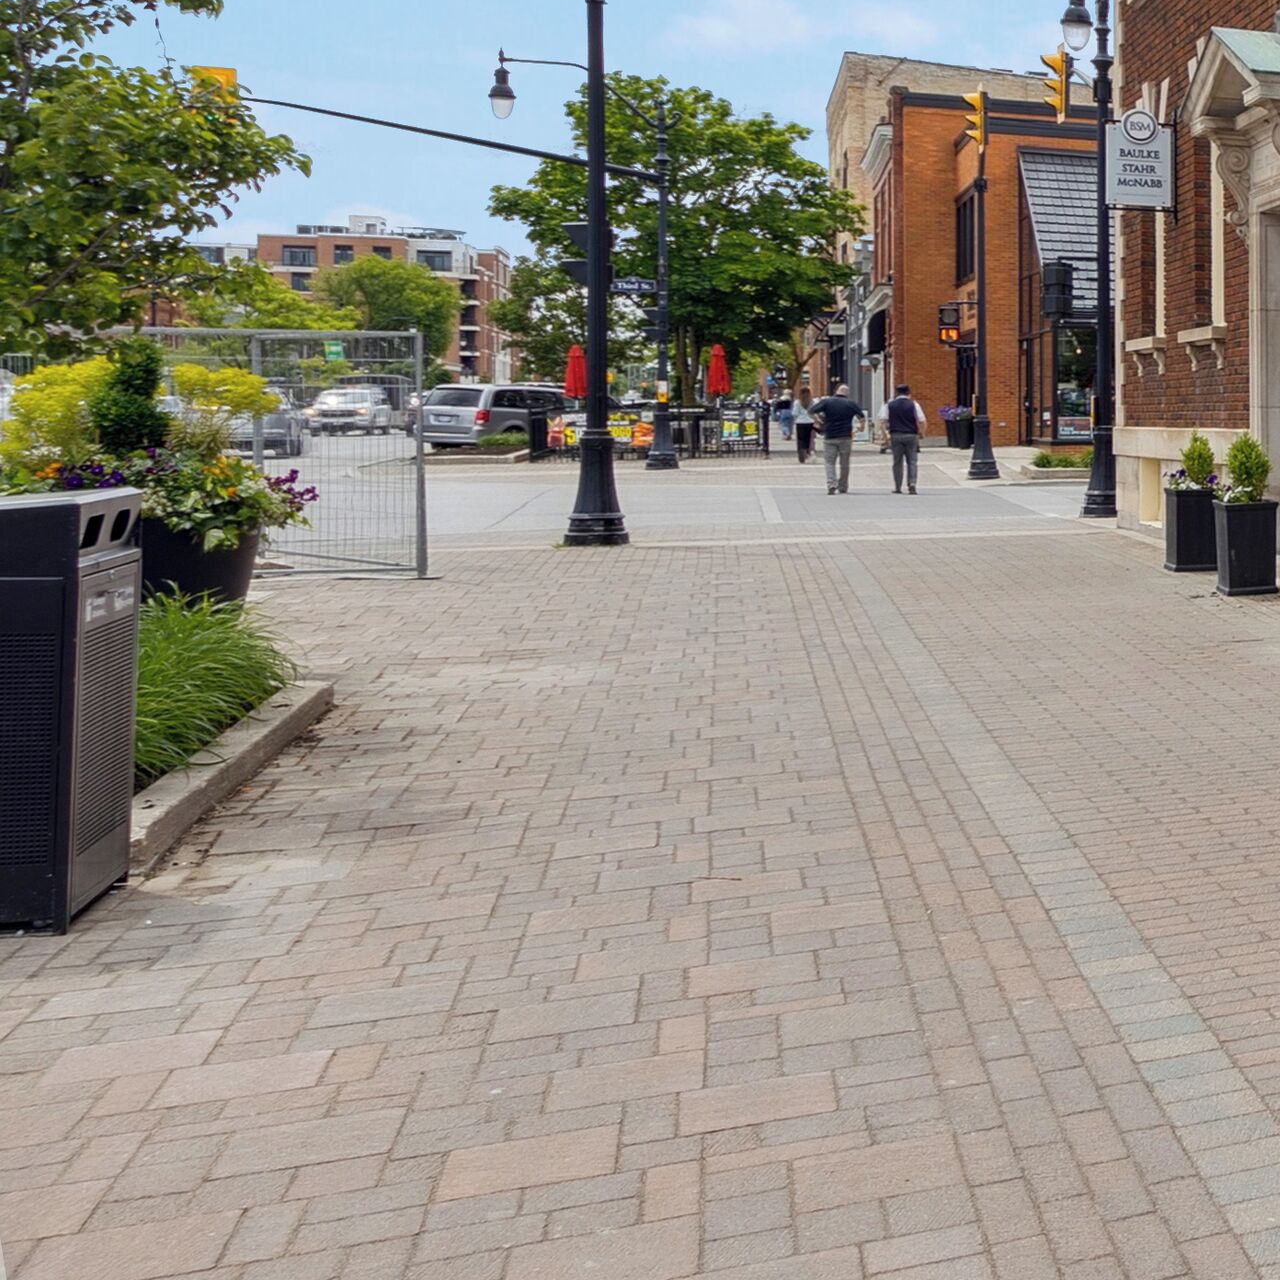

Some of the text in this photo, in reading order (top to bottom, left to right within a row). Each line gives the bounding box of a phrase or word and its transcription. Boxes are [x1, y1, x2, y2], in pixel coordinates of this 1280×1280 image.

[1129, 121, 1152, 132] BSM
[1119, 148, 1160, 160] BAULKE
[1122, 163, 1157, 174] STAHR
